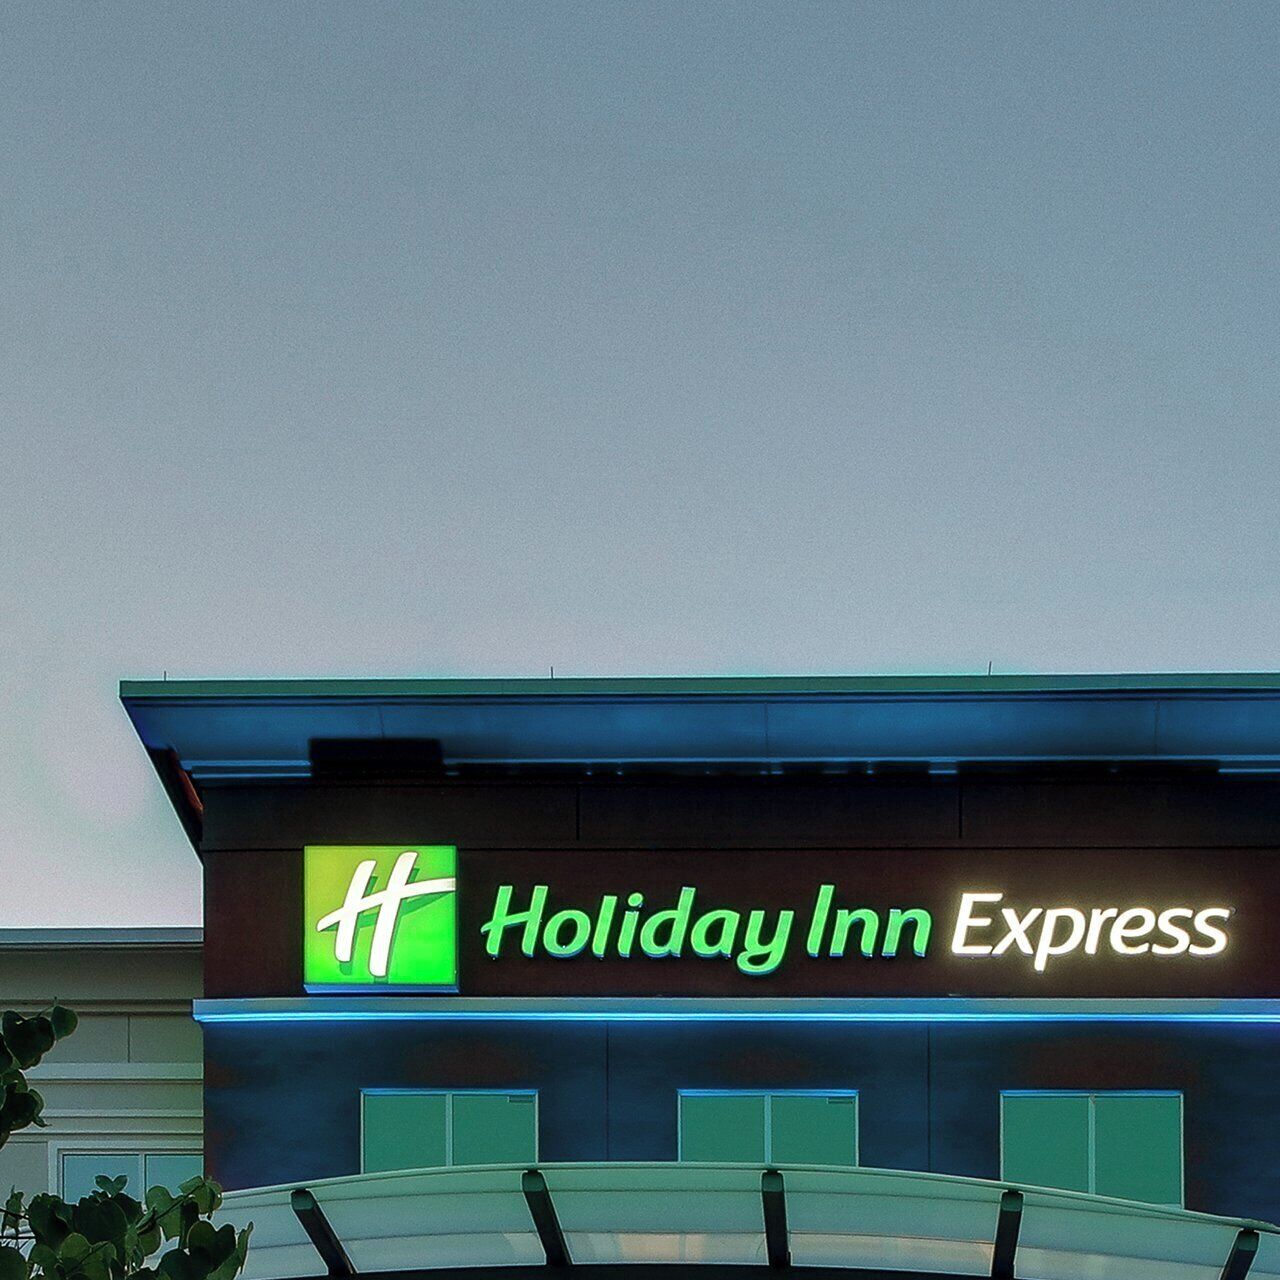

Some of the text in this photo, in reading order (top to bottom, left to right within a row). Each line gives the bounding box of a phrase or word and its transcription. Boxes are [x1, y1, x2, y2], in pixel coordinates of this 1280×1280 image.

[480, 884, 1231, 976] Holiday Inn Express
